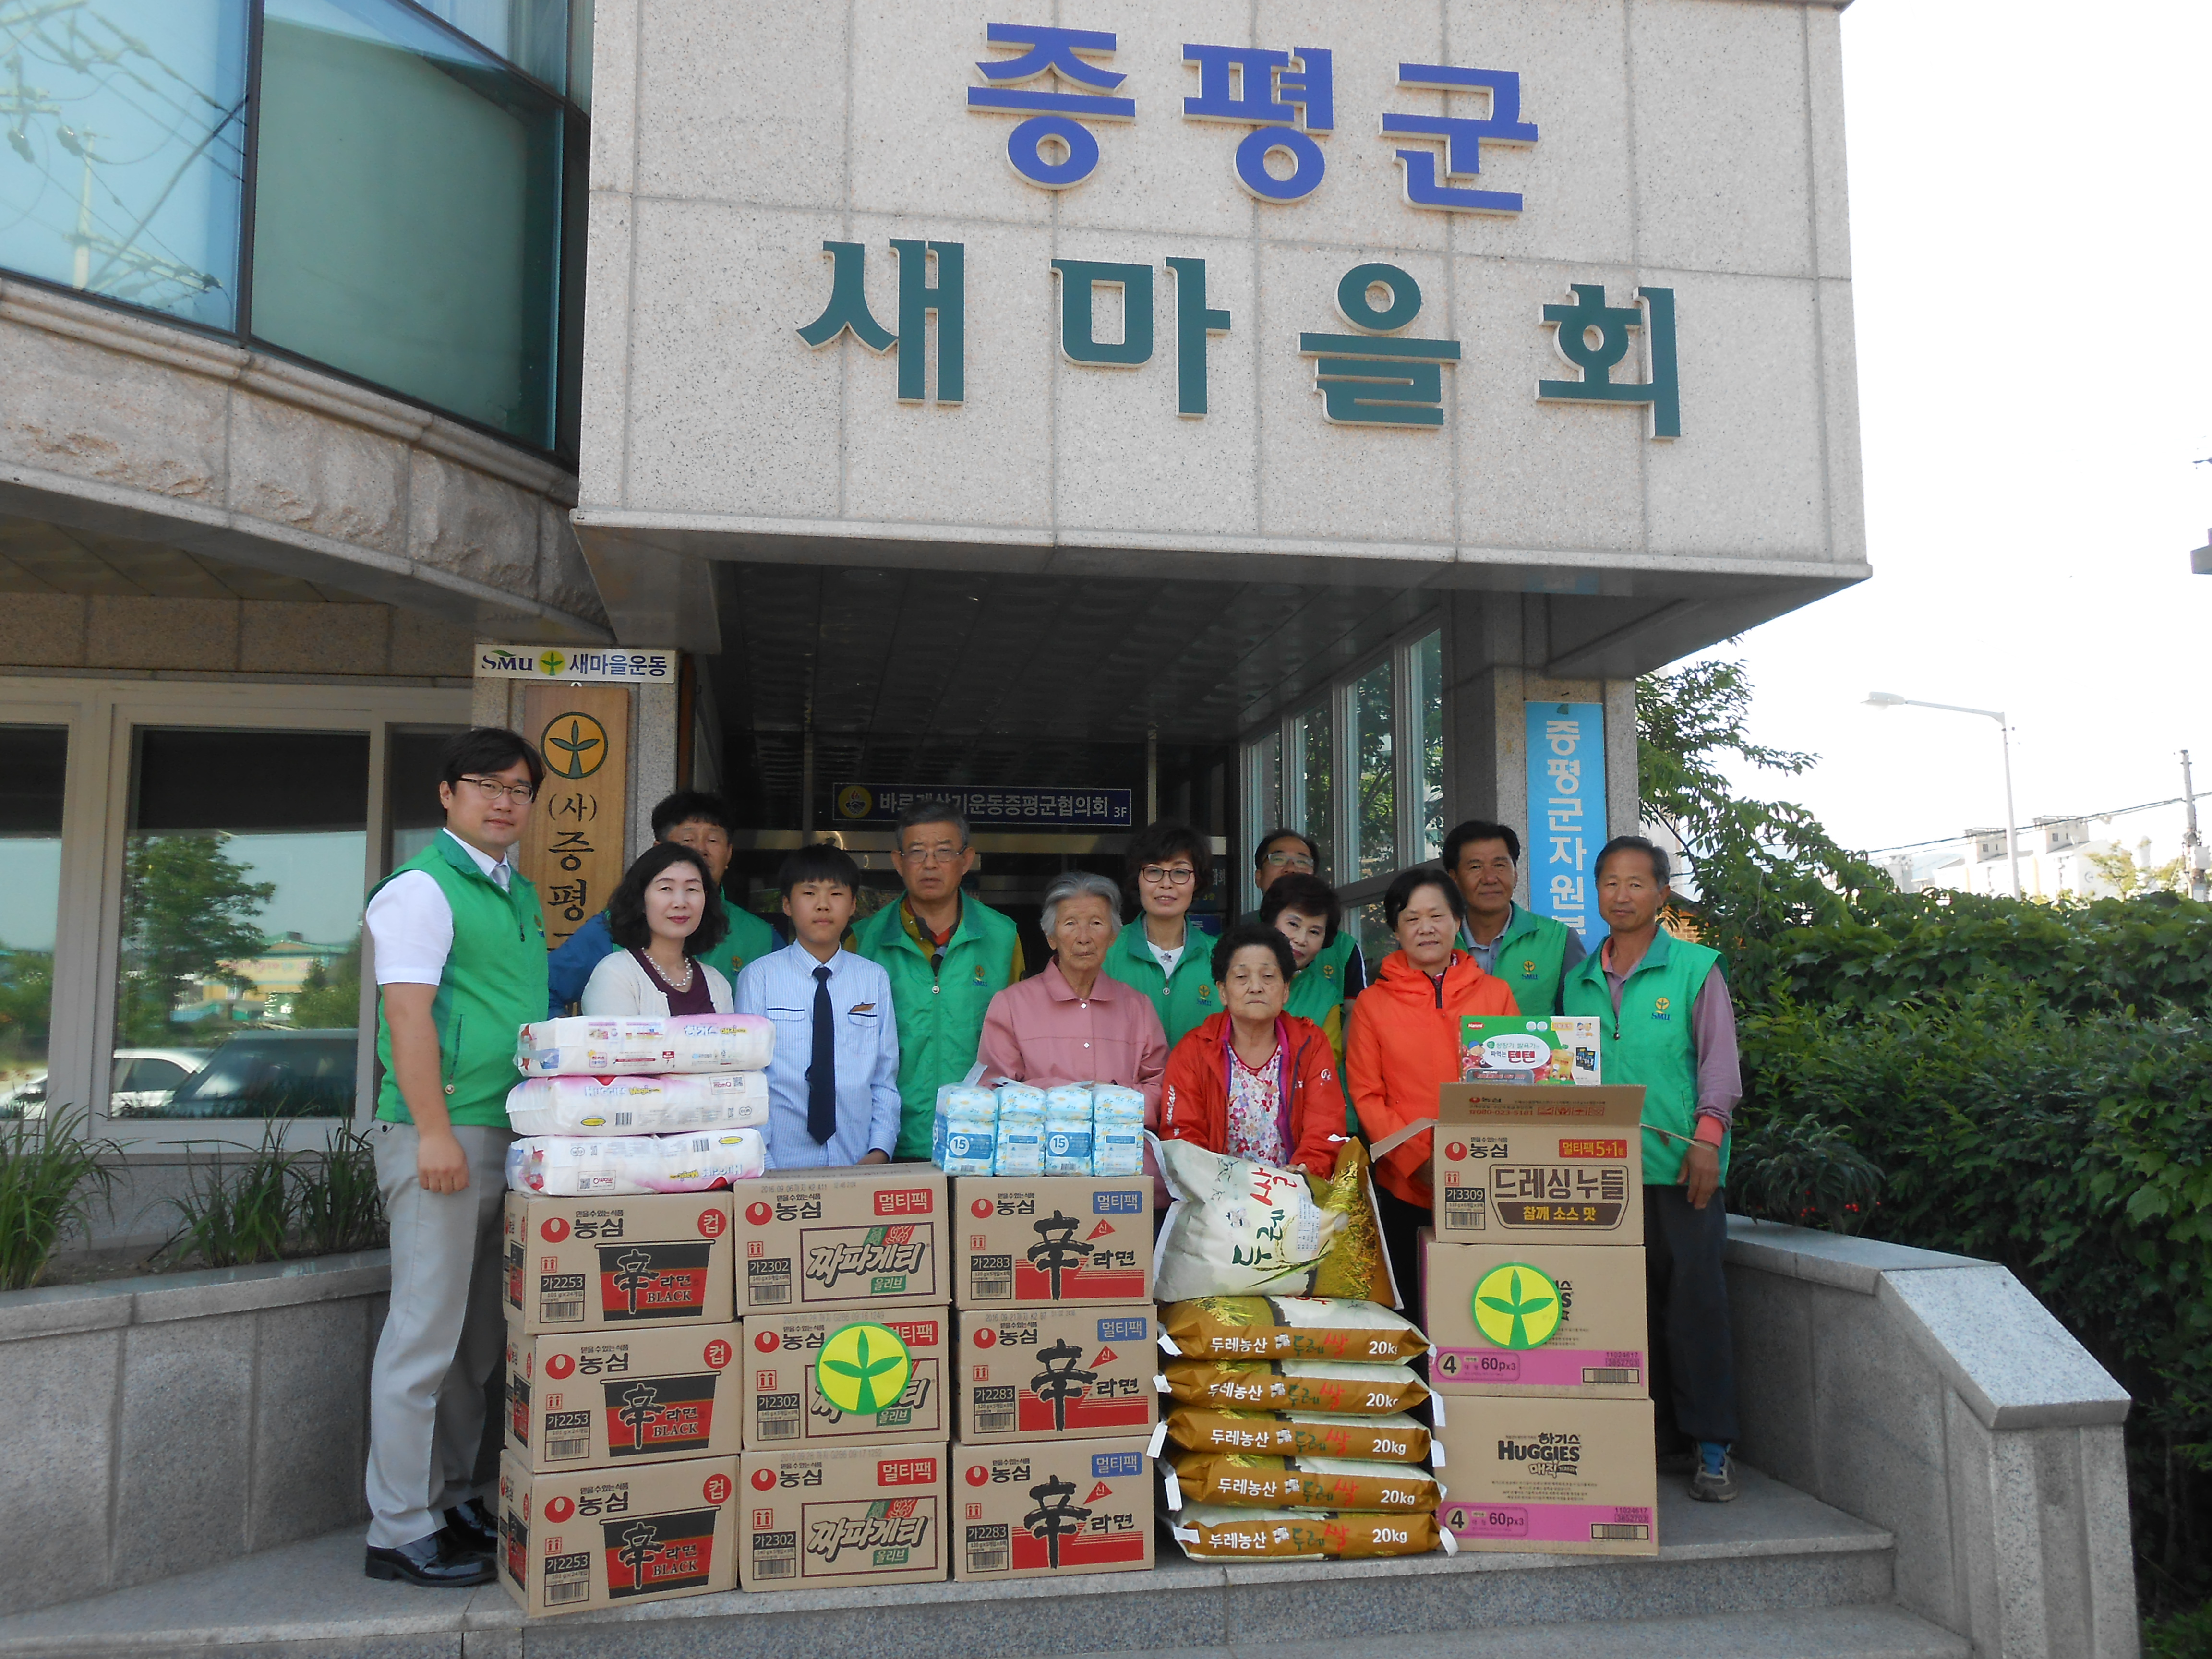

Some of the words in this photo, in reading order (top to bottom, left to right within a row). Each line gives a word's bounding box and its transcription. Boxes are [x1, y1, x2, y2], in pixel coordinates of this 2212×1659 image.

[966, 22, 1539, 216] 증평군
[795, 238, 1681, 441] 새마을회
[481, 654, 533, 672] SMU
[569, 653, 667, 677] 새마을운동
[1114, 807, 1127, 818] 3F
[1507, 1050, 1536, 1064] 텐텐
[585, 1087, 627, 1097] HUGGIES
[629, 1085, 652, 1095] Magic
[953, 1139, 966, 1150] 15
[1053, 1137, 1066, 1149] 15
[1469, 1143, 1508, 1159] 농심
[1563, 1142, 1594, 1155] 멀티팩
[1494, 1168, 1570, 1199] 드레싱
[1577, 1169, 1624, 1200] 누들
[879, 1192, 927, 1212] 멀티팩
[1097, 1194, 1138, 1211] 멀티팩
[1447, 1189, 1483, 1200] 가3309
[775, 1201, 822, 1221] 농심
[997, 1200, 1034, 1215] 농심
[1523, 1206, 1549, 1221] 참깨
[1553, 1207, 1579, 1221] 소스
[1583, 1206, 1596, 1222] 맛
[574, 1218, 623, 1239] 농심
[704, 1214, 718, 1234] 컵
[1098, 1224, 1107, 1234] 신
[805, 1241, 927, 1288] 짜파게티
[973, 1257, 1010, 1269] 가2283
[1027, 1210, 1094, 1301] 辛
[1093, 1250, 1136, 1269] 라면
[750, 1261, 789, 1274] 가2302
[543, 1276, 583, 1290] 가2253
[613, 1249, 660, 1315] 辛
[659, 1274, 692, 1287] 라면
[874, 1276, 902, 1291] 올리브
[646, 1290, 692, 1303] BLACK
[999, 1329, 1038, 1346] 농심
[1102, 1321, 1142, 1337] 멀티팩
[782, 1331, 825, 1351] 농심
[1210, 1335, 1268, 1354] 두레농산
[709, 1345, 724, 1364] 컵
[1101, 1350, 1110, 1361] 신
[579, 1353, 629, 1375] 농심
[1443, 1355, 1457, 1374] 4
[1030, 1338, 1098, 1431] 辛
[1097, 1378, 1140, 1397] 라면
[1208, 1382, 1263, 1401] 두레농산
[759, 1396, 797, 1408] 가2302
[976, 1388, 1013, 1401] 가2283
[548, 1413, 589, 1428] 가2253
[619, 1383, 666, 1450] 辛
[665, 1407, 698, 1423] 라면
[879, 1410, 908, 1424] 올리브
[652, 1422, 698, 1438] BLACK
[1538, 1432, 1580, 1445] 하기스
[1210, 1429, 1270, 1448] 두레농산
[1372, 1439, 1407, 1455] 20kg
[1498, 1440, 1580, 1462] HUGGIES
[882, 1461, 931, 1481] 멀티팩
[1096, 1455, 1137, 1473] 멀티팩
[1528, 1461, 1558, 1479] 매직
[780, 1469, 822, 1488] 농심
[991, 1465, 1030, 1484] 농심
[709, 1479, 724, 1500] 컵
[1095, 1485, 1105, 1496] 신
[1217, 1478, 1277, 1497] 두레농산
[1380, 1489, 1415, 1505] 20kg
[578, 1491, 629, 1517] 농심
[1024, 1475, 1092, 1570] 辛
[1090, 1513, 1134, 1533] 라면
[1451, 1510, 1465, 1528] 4
[755, 1534, 794, 1547] 가2302
[807, 1515, 929, 1563] 짜파게티
[968, 1527, 1006, 1539] 가2283
[1208, 1531, 1267, 1549] 두레농산
[1372, 1528, 1407, 1544] 20kg
[618, 1522, 666, 1590] 辛
[665, 1543, 697, 1560] 라면
[877, 1550, 905, 1564] 올리브
[547, 1555, 588, 1571] 가2253
[652, 1559, 698, 1577] BLACK
